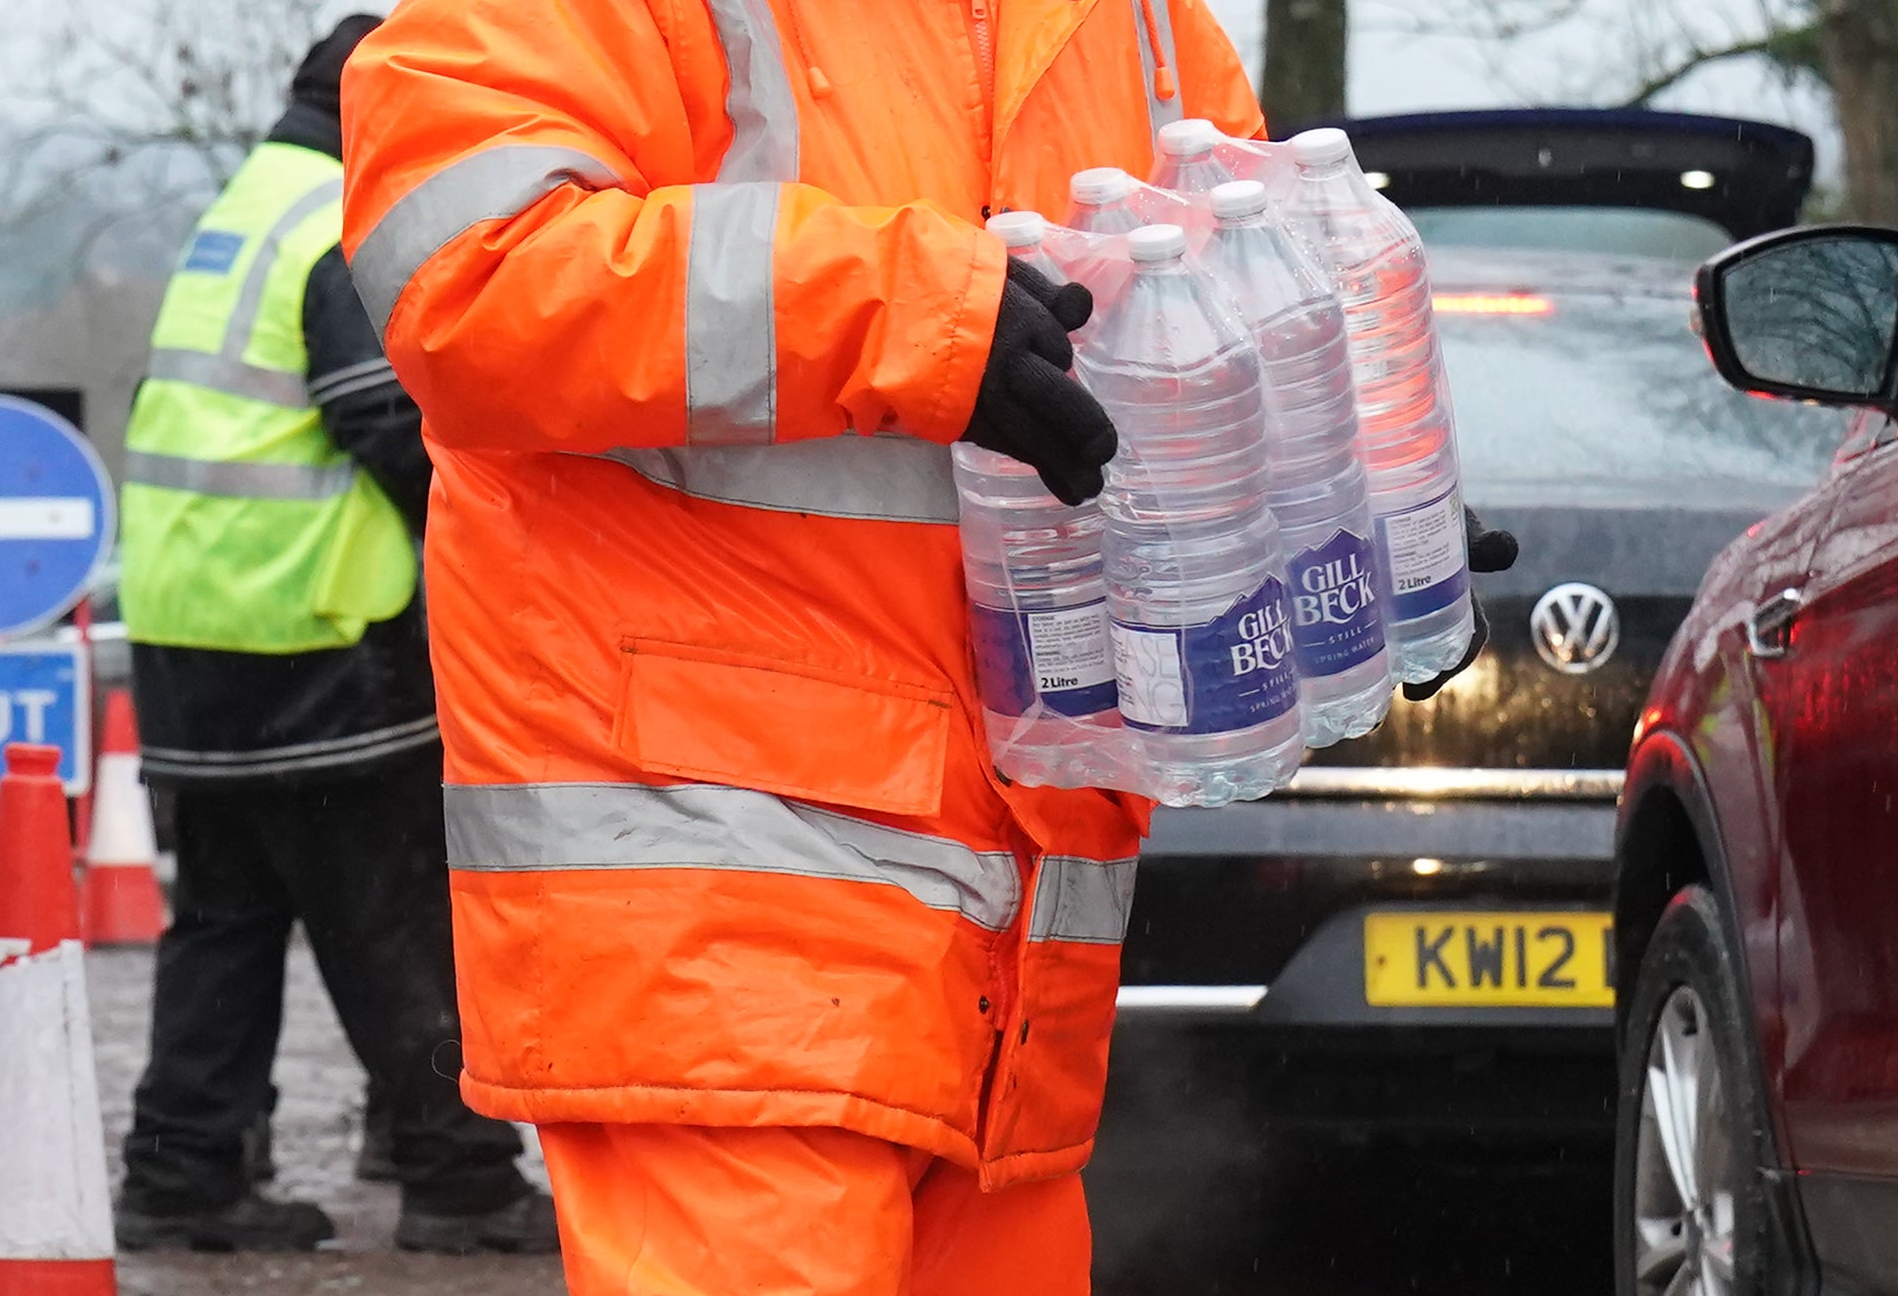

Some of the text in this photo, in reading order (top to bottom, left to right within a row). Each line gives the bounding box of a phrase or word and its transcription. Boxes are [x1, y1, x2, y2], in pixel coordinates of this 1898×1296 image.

[1302, 553, 1365, 594] GILL
[1399, 575, 1432, 591] 2 Litre
[1238, 598, 1288, 640] GILL
[1293, 571, 1375, 626] BECK
[1230, 616, 1294, 677] BECK
[1329, 626, 1362, 645] STILL
[1041, 677, 1078, 689] 2 Litre
[1414, 925, 1577, 990] KW12
